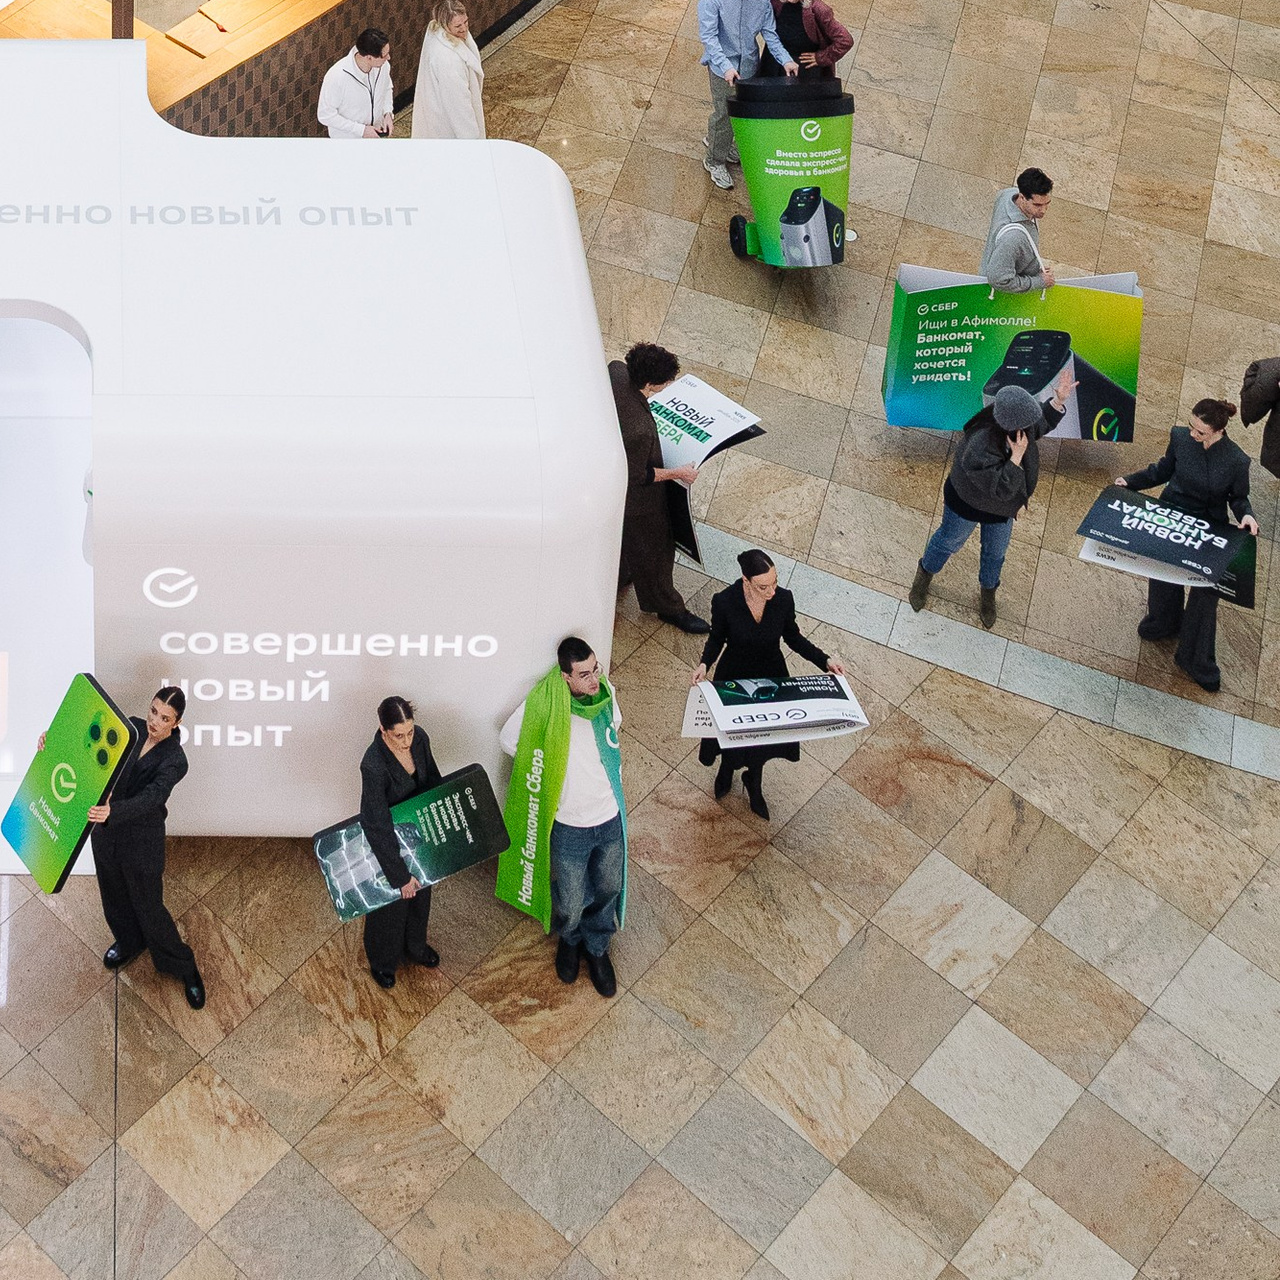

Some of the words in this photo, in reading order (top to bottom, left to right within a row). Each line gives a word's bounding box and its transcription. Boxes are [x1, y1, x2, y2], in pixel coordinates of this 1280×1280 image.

[129, 197, 282, 226] новый
[298, 204, 419, 227] опыт
[918, 318, 947, 330] Ищи
[951, 319, 958, 327] в
[961, 314, 1037, 327] Афимолле!
[931, 302, 958, 312] СБЕР
[915, 342, 973, 357] который
[916, 330, 985, 344] Банкомат,
[911, 371, 971, 384] увидеть!
[913, 358, 966, 370] хочется
[649, 400, 713, 444] БАНКОМАТ
[666, 397, 716, 428] НОВЫЙ
[1108, 499, 1230, 549] БАНКОМАТ
[1145, 500, 1210, 530] СБЕРА
[1121, 514, 1203, 550] НОВЫЙ
[159, 631, 499, 663] совершенно
[732, 712, 781, 724] СБЕР
[180, 725, 292, 747] пыт
[526, 748, 544, 794] Сбера
[29, 801, 59, 843] банкомат
[38, 795, 61, 827] Новый
[429, 802, 447, 843] банкомате
[438, 805, 451, 830] новом
[444, 796, 460, 832] здоровья
[452, 792, 474, 844] Экспресс-чек
[521, 796, 540, 861] банкомат
[518, 859, 534, 907] Новый
